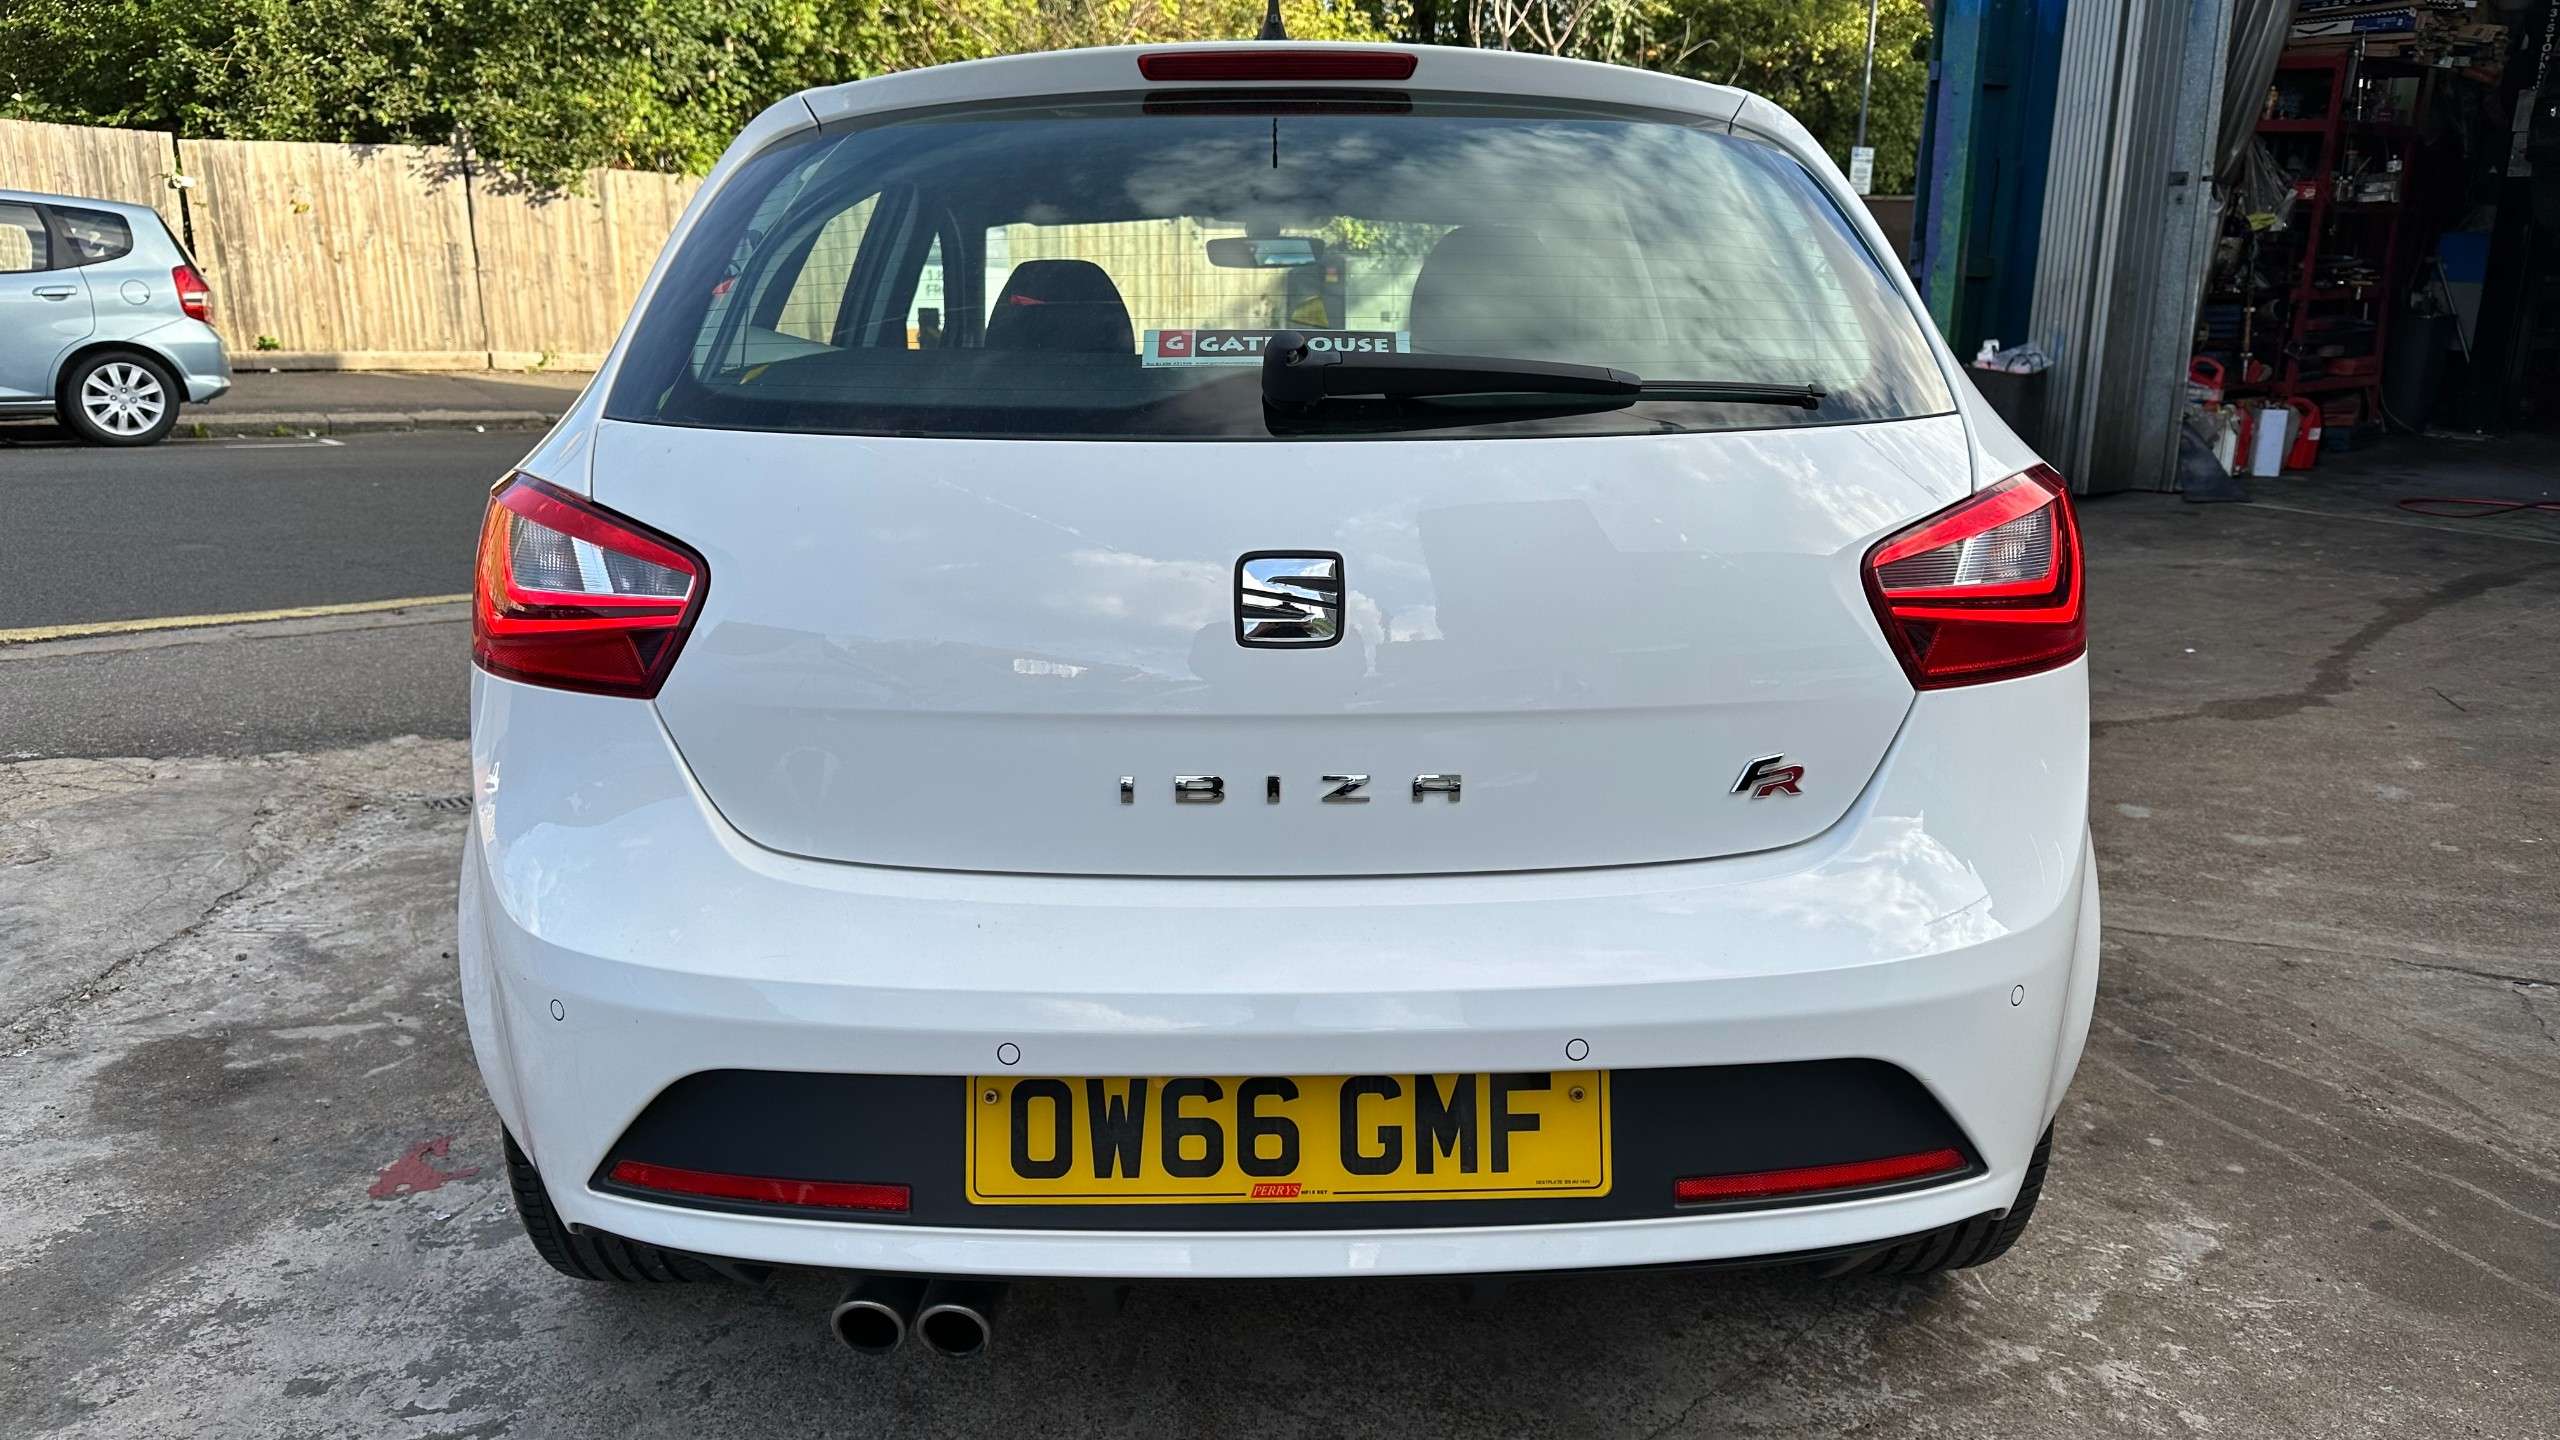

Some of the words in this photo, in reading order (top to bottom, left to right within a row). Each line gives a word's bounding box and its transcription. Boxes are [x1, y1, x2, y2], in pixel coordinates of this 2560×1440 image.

[1166, 335, 1184, 350] G
[1199, 335, 1389, 353] GATOUSE
[1119, 774, 1463, 804] IBIZA
[1730, 752, 1805, 799] FR
[1010, 1078, 1302, 1179] OW66
[1339, 1074, 1552, 1176] GMF
[1253, 1185, 1300, 1196] PERRYS
